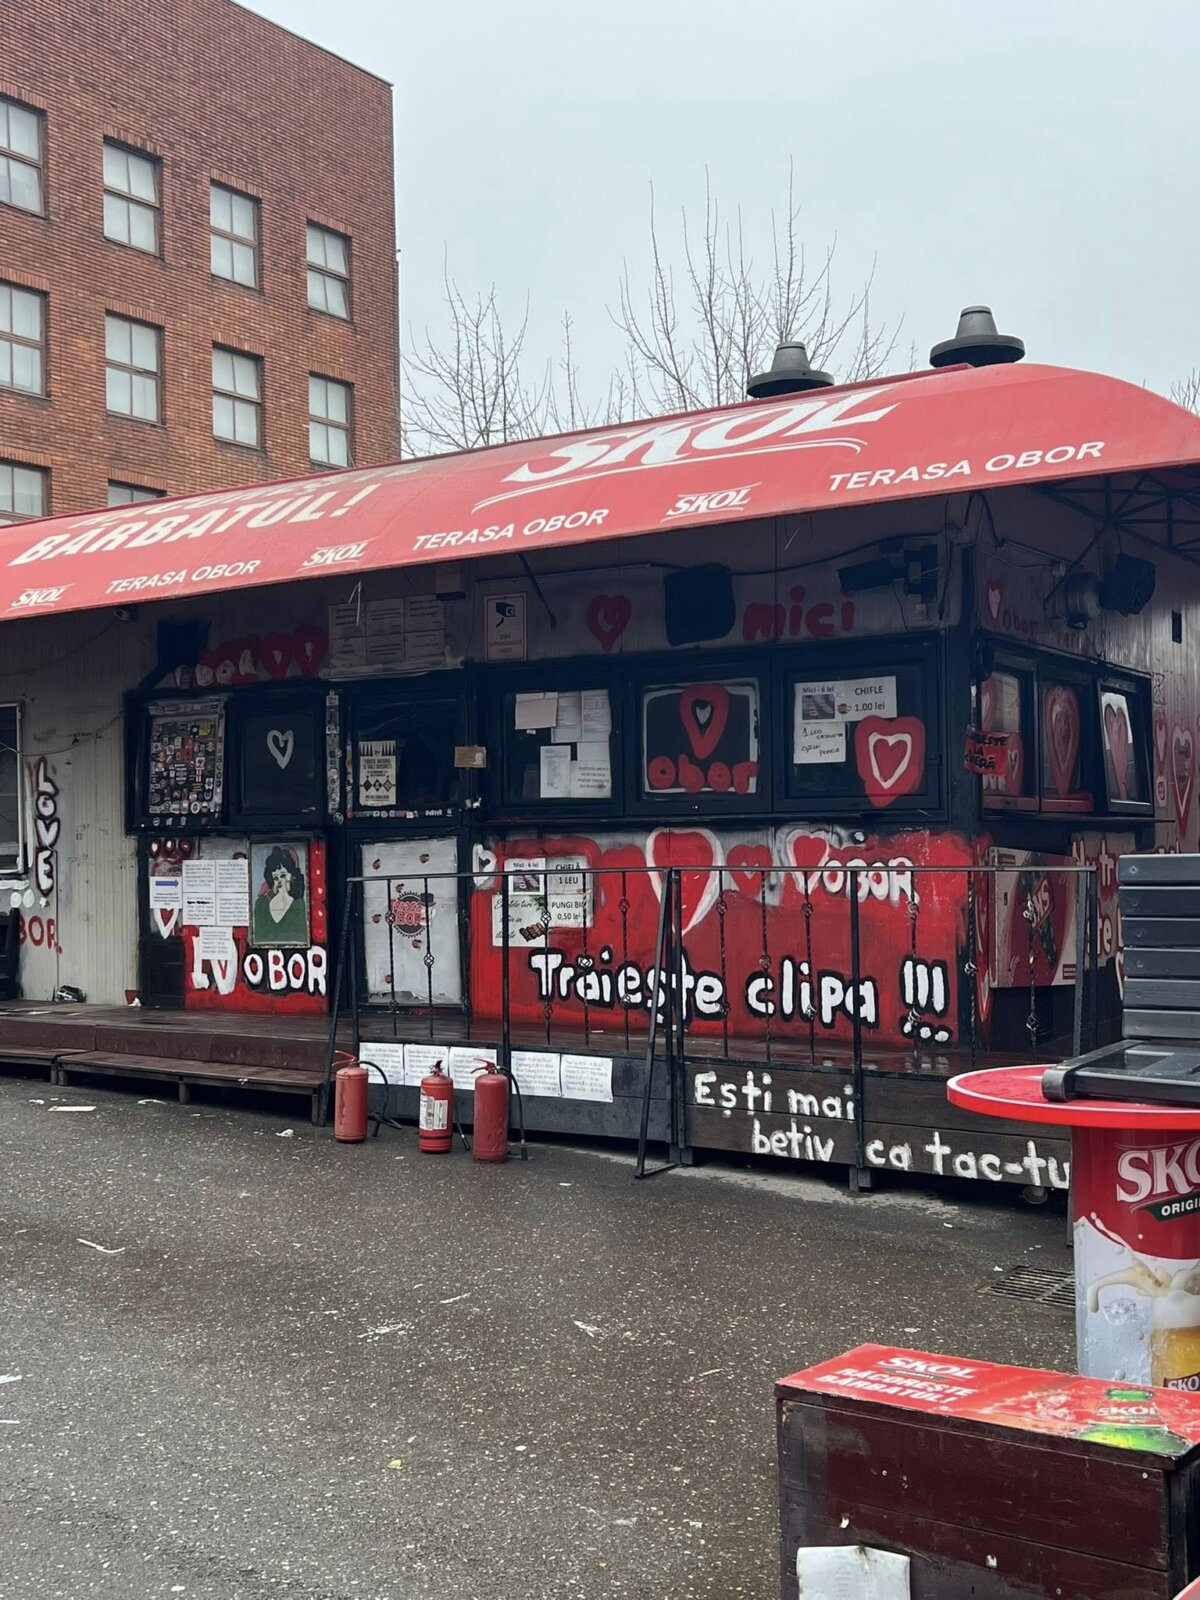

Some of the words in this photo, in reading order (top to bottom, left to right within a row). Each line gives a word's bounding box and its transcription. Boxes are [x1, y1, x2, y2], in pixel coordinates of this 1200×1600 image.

[500, 386, 901, 482] SKOL
[828, 459, 971, 491] TERASA
[985, 441, 1105, 472] OBOR
[666, 487, 752, 517] SKOL
[412, 523, 514, 550] TERASA
[522, 509, 609, 536] OBOR
[303, 542, 369, 566] SKOL
[11, 586, 68, 607] SKOL
[106, 571, 186, 594] TERASA
[191, 560, 261, 580] OBOR
[742, 585, 856, 641] mici
[854, 686, 884, 696] CHIFLE
[854, 704, 872, 712] 1.00
[874, 702, 886, 711] lei
[34, 756, 60, 897] LOVE
[564, 876, 579, 884] LEU
[823, 857, 919, 907] OBOR
[244, 946, 327, 995] OBOR
[747, 959, 878, 1024] clipa
[694, 1070, 773, 1118] Ești
[787, 1084, 855, 1121] mai
[753, 1118, 834, 1163] betiv
[866, 1140, 914, 1171] ca
[877, 1356, 976, 1379] SKOL
